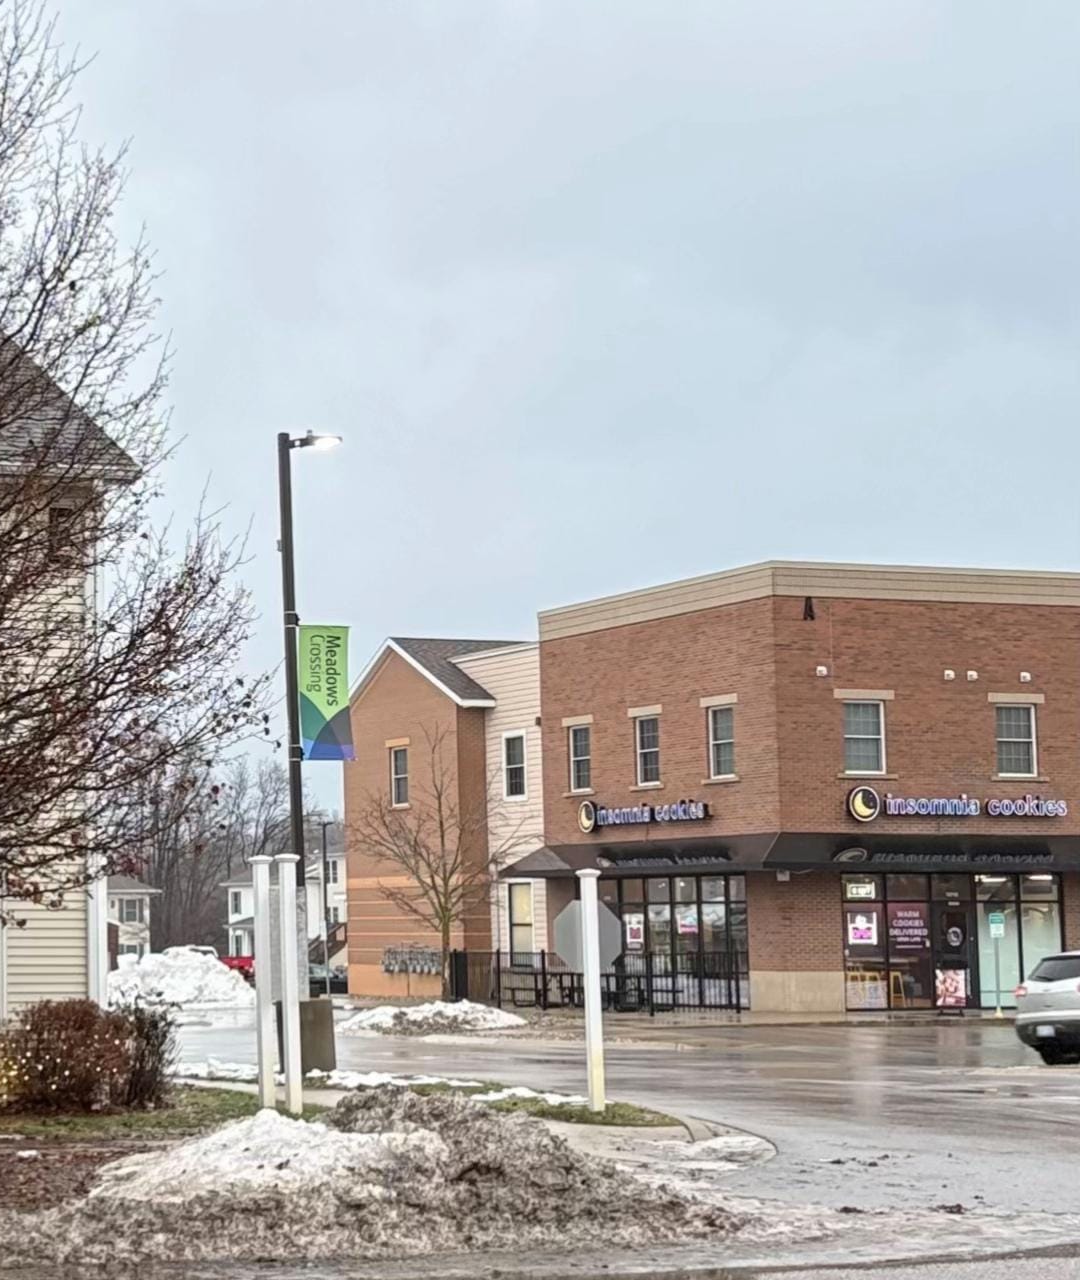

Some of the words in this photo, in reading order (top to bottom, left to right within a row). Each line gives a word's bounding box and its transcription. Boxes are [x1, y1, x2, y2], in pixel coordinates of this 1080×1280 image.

[306, 634, 325, 693] Crossing
[325, 634, 341, 707] Meadows
[596, 804, 651, 825] insomnia
[654, 800, 705, 821] cookies
[886, 793, 980, 815] insomnia
[987, 794, 1068, 817] cookies
